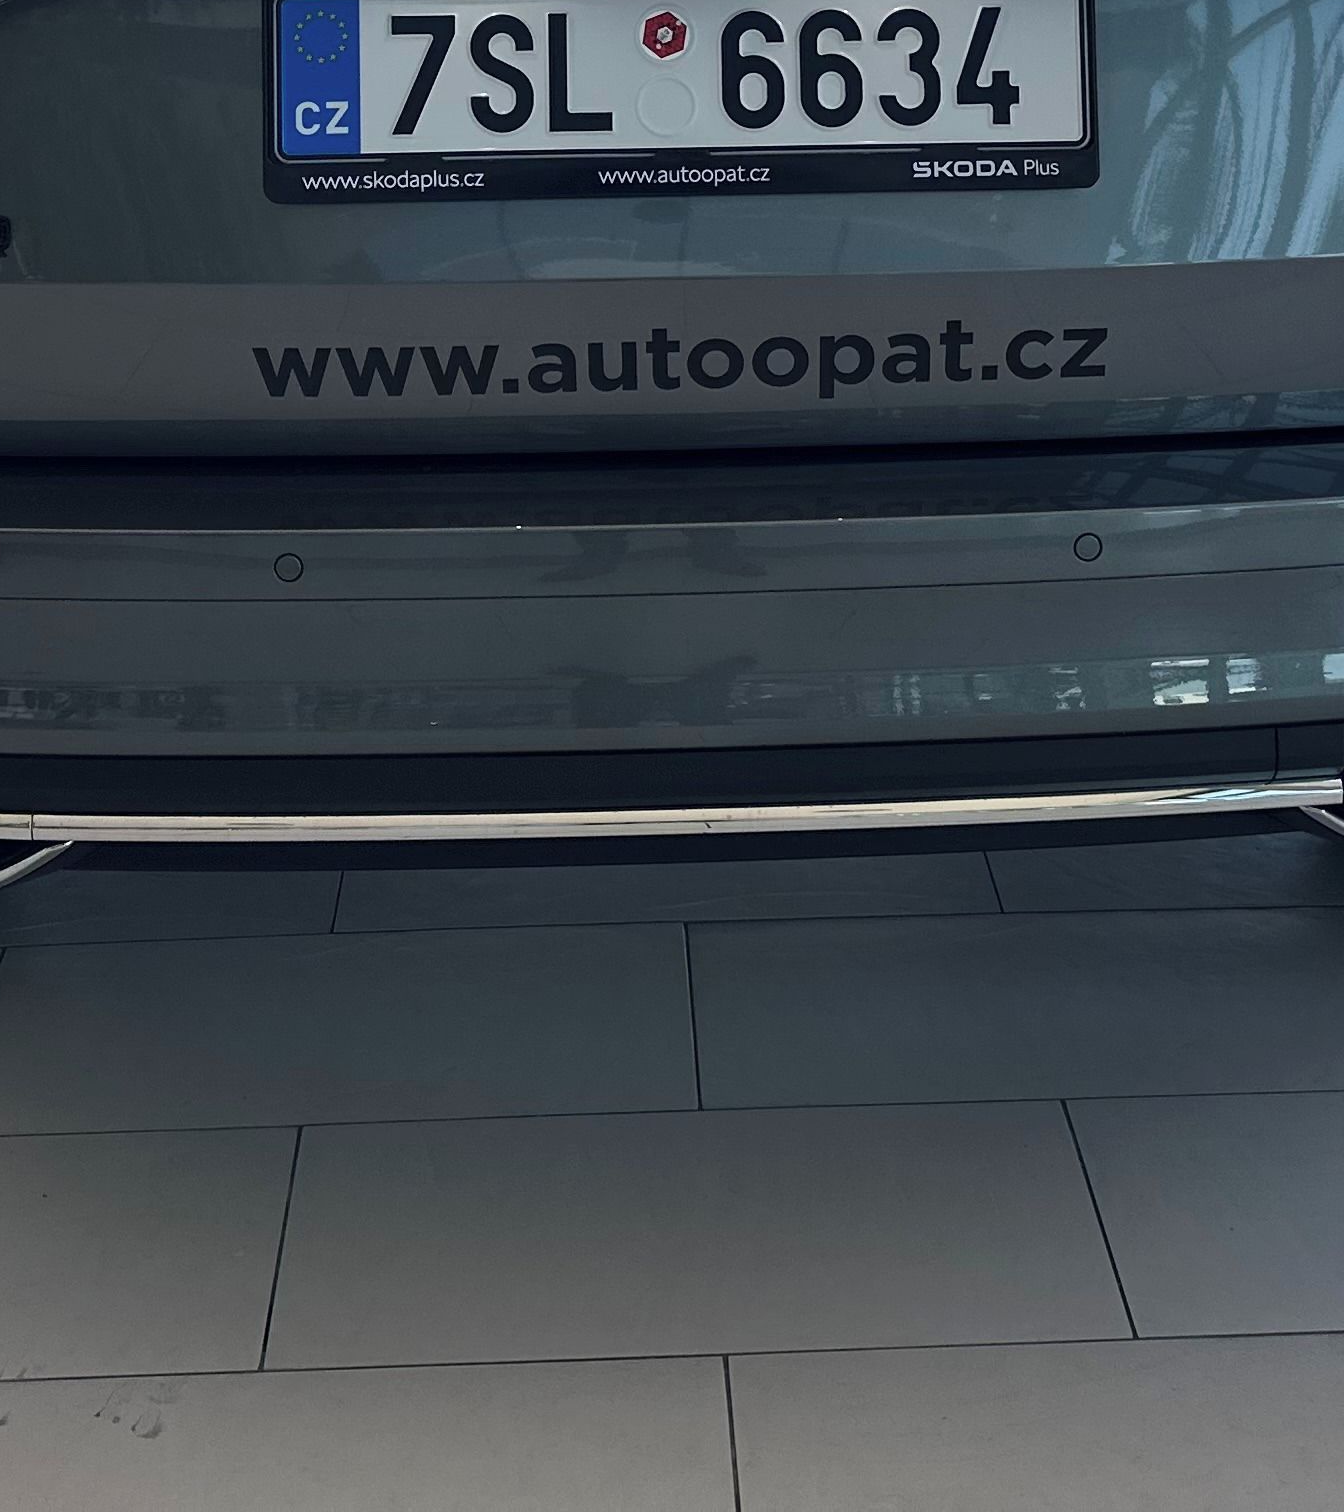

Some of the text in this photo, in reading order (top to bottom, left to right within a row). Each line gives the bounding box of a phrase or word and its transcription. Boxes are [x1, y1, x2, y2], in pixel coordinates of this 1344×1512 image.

[389, 7, 1021, 137] 7SL 6634
[294, 101, 350, 136] CZ
[301, 169, 485, 192] www.skodaplus.cz
[598, 164, 771, 188] www.autoopat.cz
[912, 158, 1060, 178] SKODA Plus
[251, 318, 1110, 400] www.autoopat.cz
